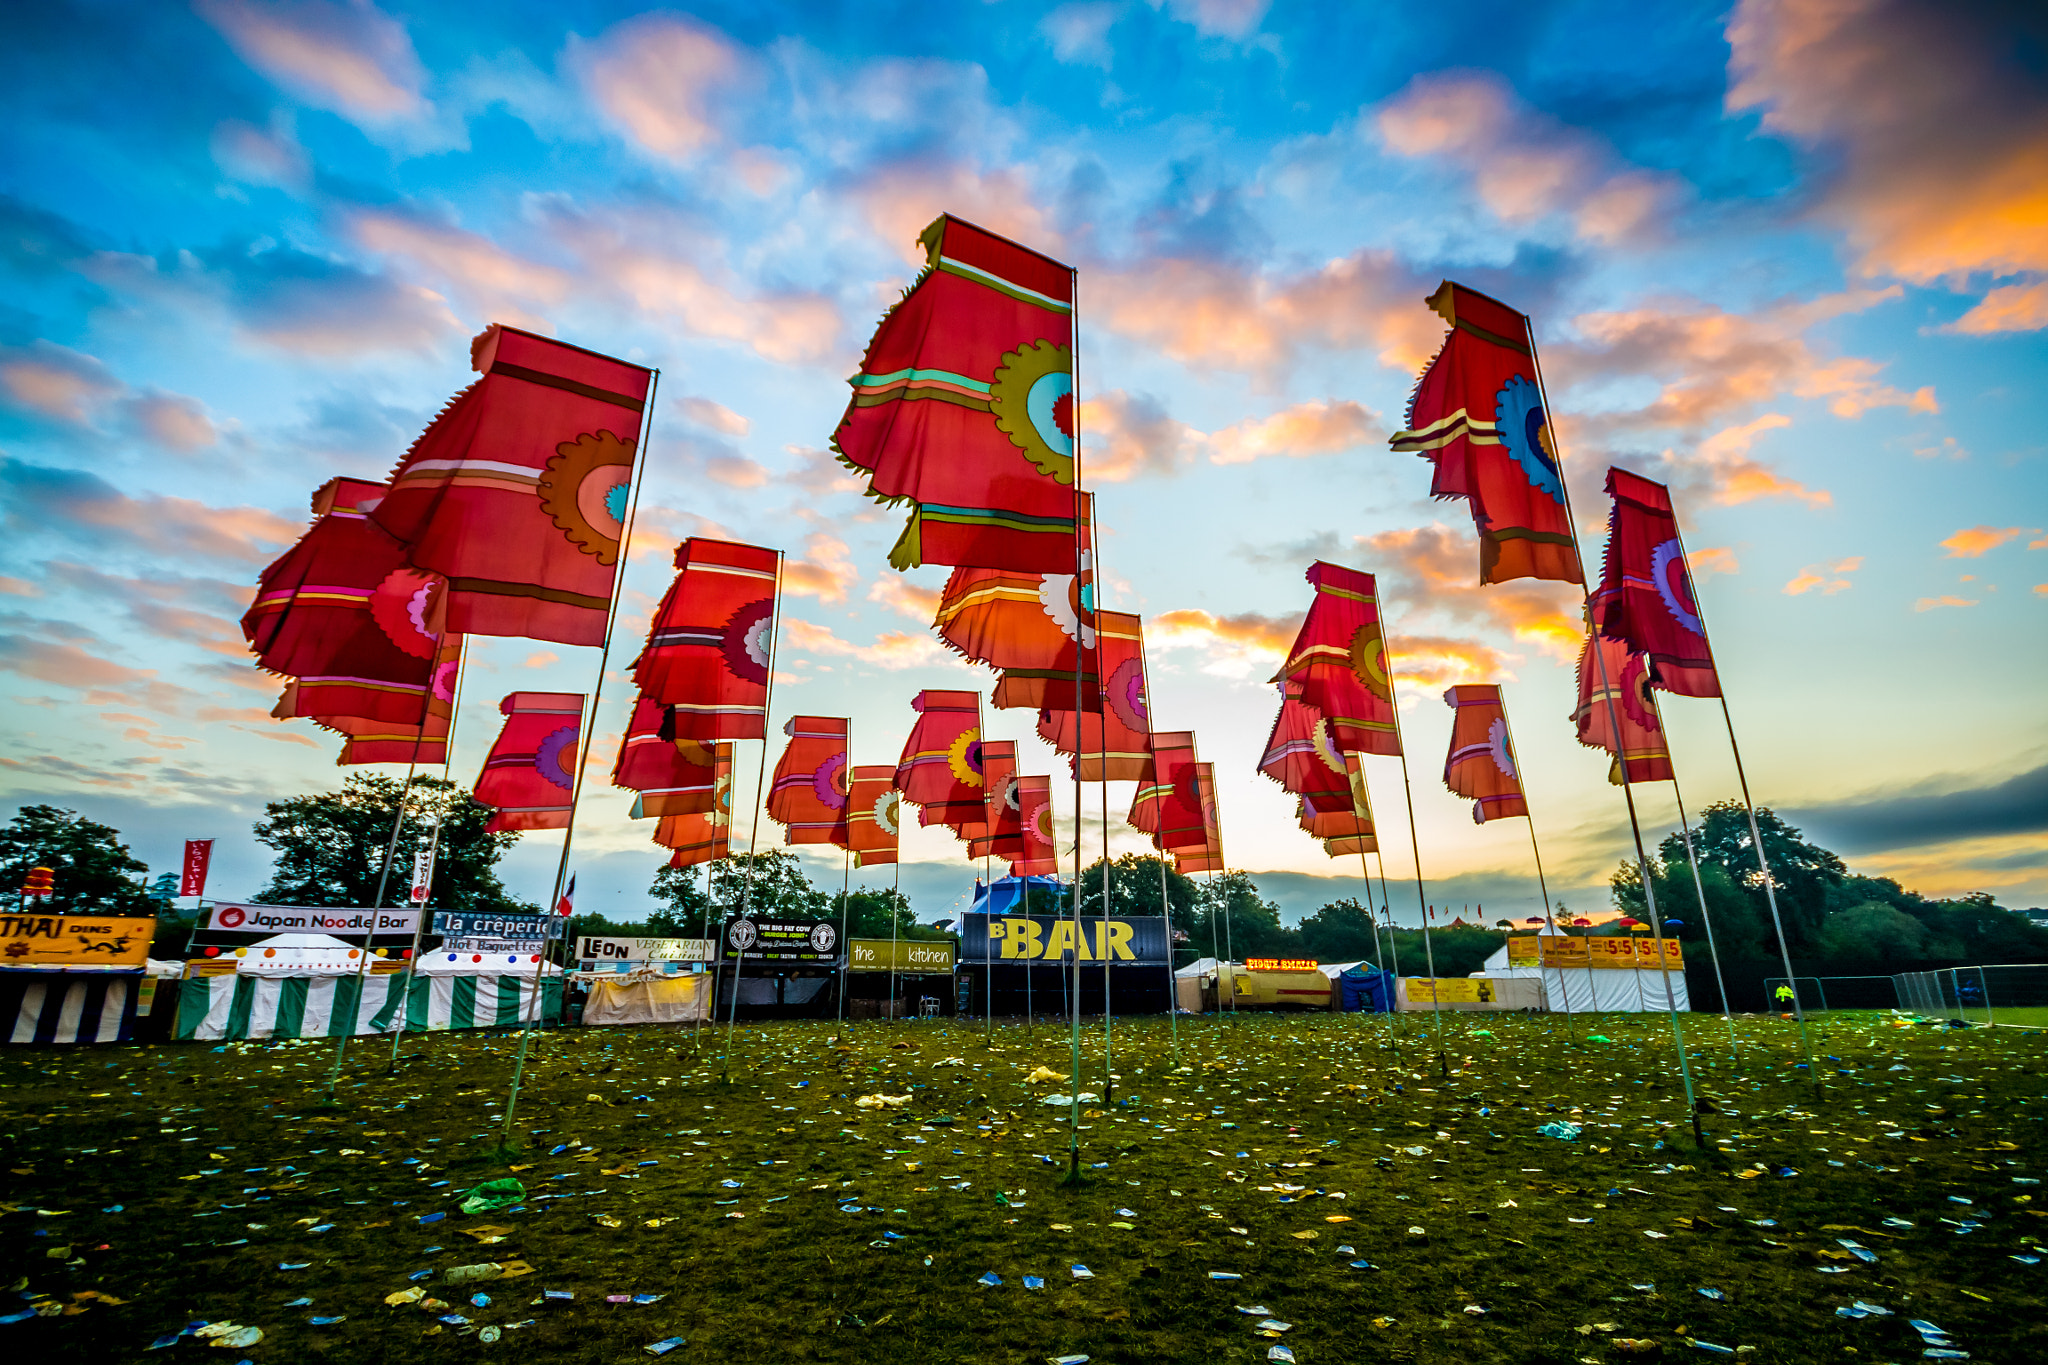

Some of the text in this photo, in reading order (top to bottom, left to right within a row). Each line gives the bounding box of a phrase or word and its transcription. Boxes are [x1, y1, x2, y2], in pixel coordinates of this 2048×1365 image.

[0, 916, 65, 939] THAI
[248, 911, 409, 930] Japan Noodle Bar
[445, 914, 549, 937] la crêperie
[448, 938, 544, 954] Hot Baguettes
[636, 939, 714, 950] VEGETARIAN
[1000, 918, 1138, 960] BAR
[647, 949, 705, 960] Cuisine
[854, 945, 875, 961] the
[908, 946, 949, 963] kitchen
